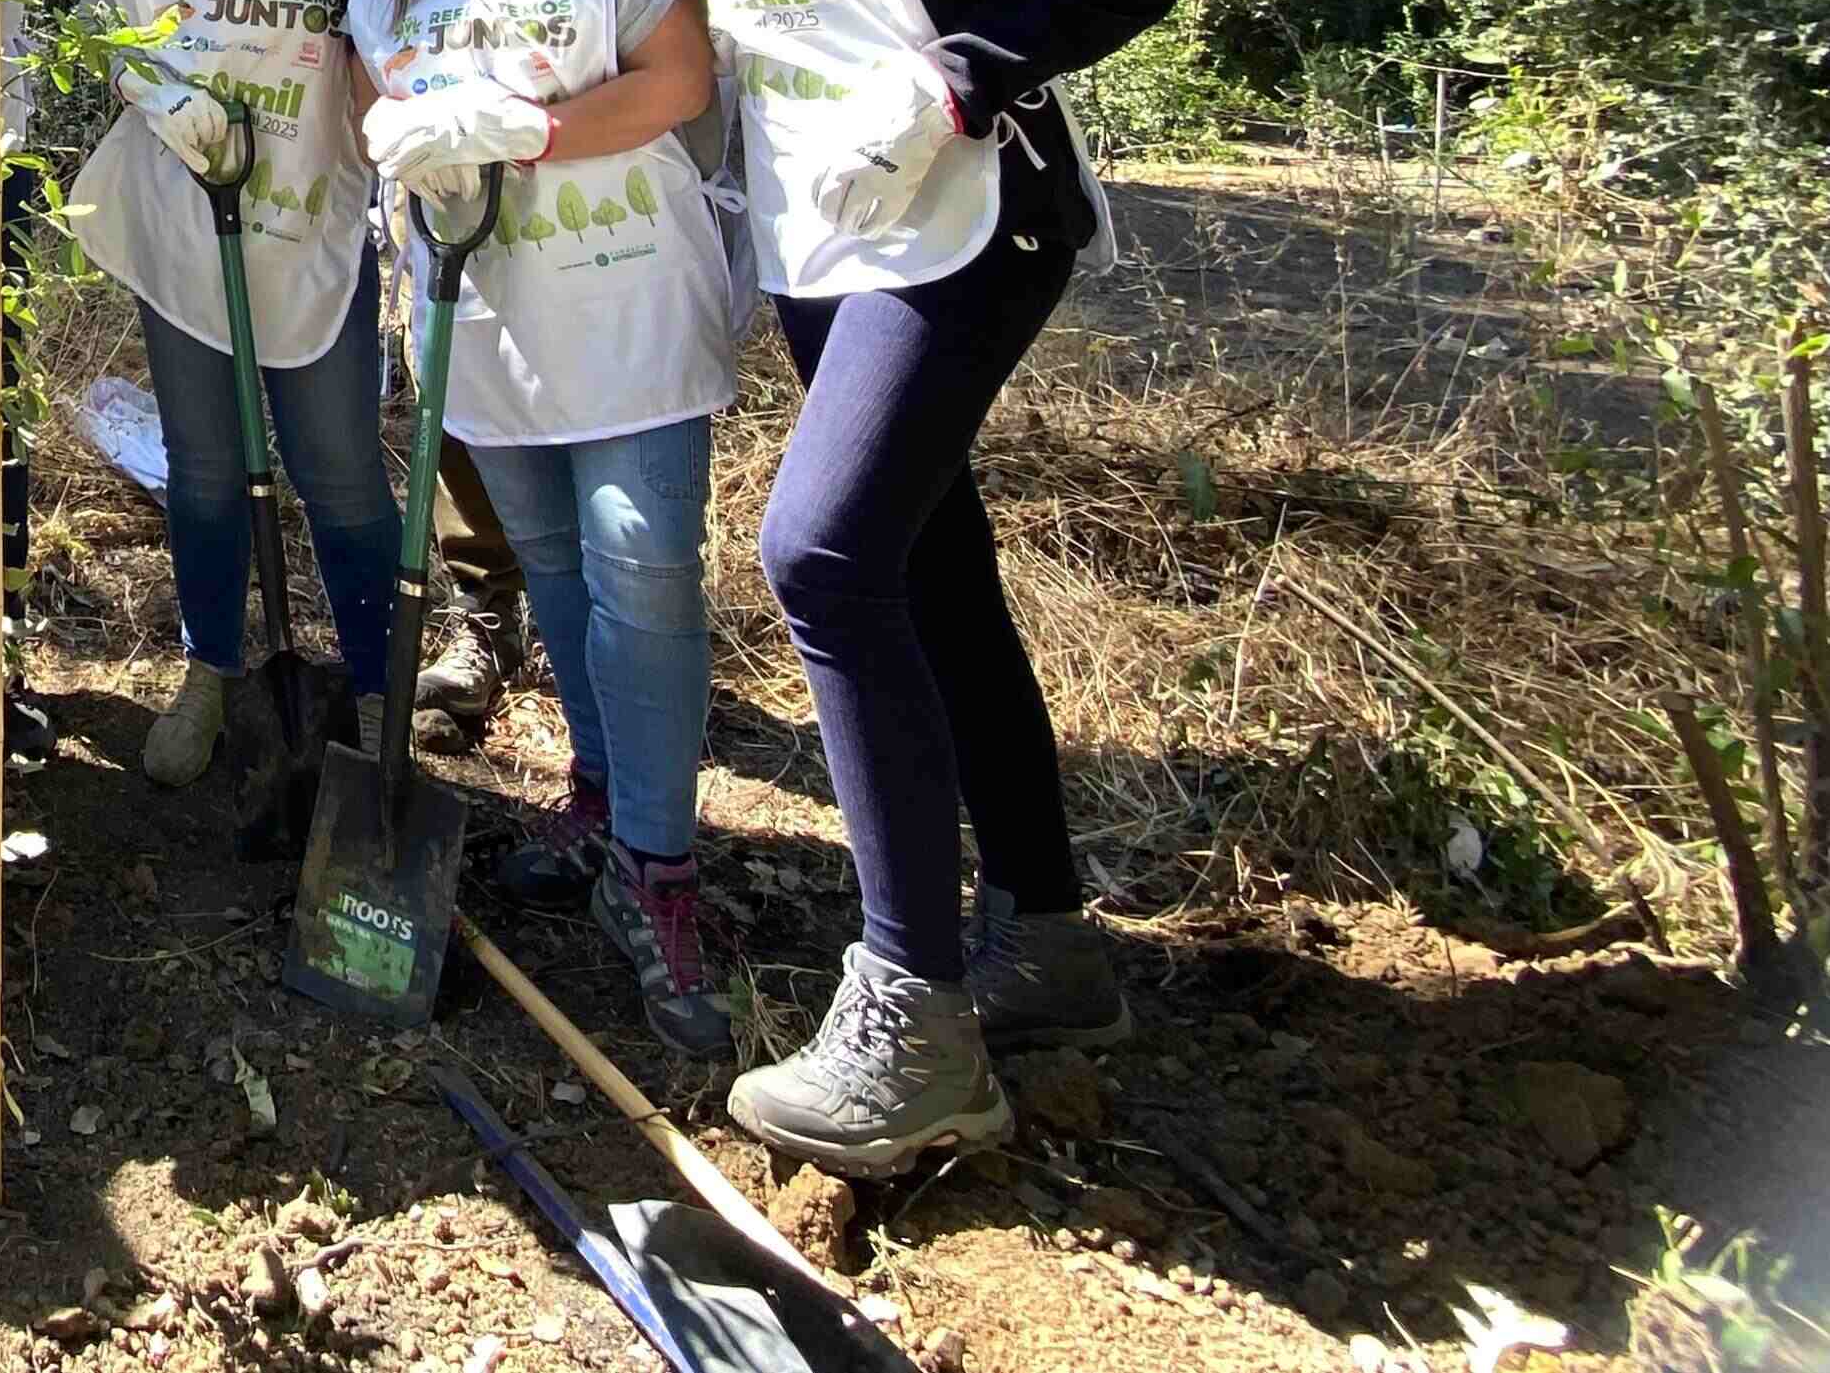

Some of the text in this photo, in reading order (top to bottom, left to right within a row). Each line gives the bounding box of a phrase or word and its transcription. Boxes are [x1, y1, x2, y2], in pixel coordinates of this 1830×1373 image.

[772, 9, 820, 29] 2025
[233, 77, 306, 119] mil
[265, 116, 298, 138] 2025
